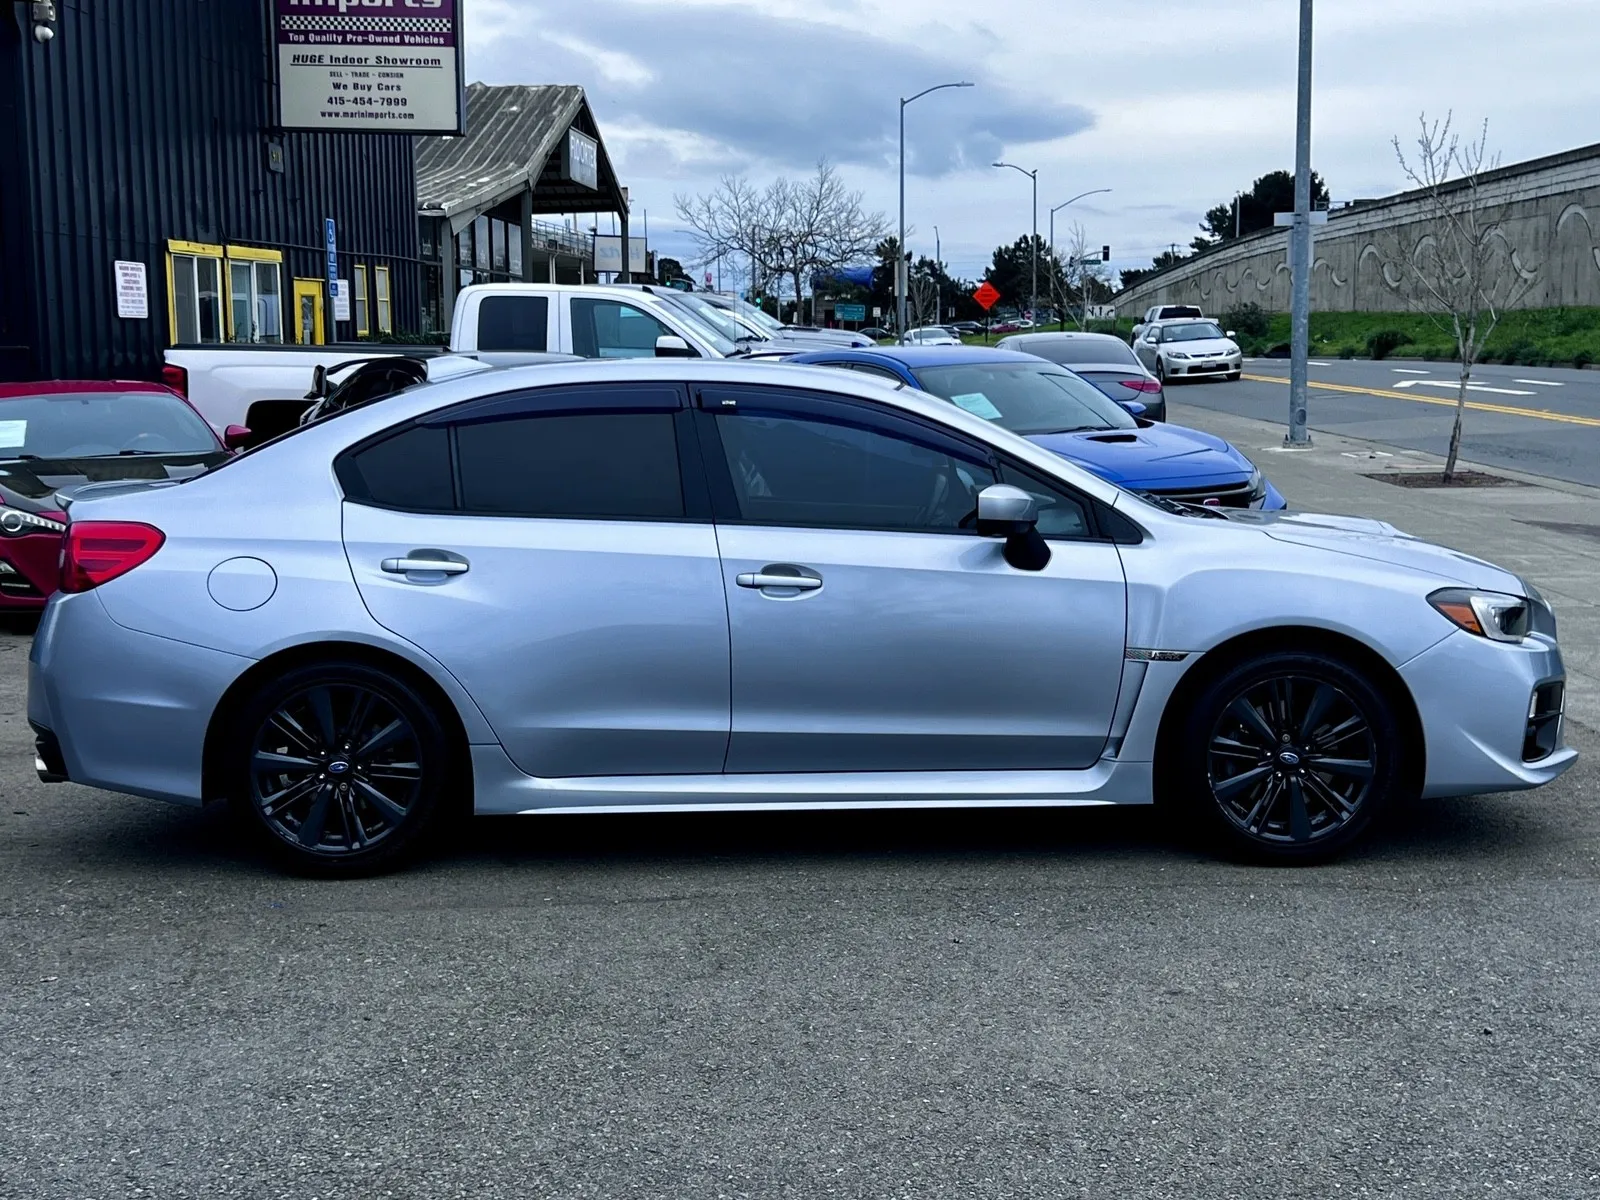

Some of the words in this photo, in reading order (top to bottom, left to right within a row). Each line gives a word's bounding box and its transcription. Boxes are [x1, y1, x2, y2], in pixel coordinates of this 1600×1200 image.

[288, 33, 305, 42] Top
[308, 33, 343, 43] Quality
[346, 34, 400, 43] Pre-Owned
[404, 35, 445, 44] Vehicles
[292, 54, 325, 64] HUGE
[329, 55, 370, 64] Indoor
[375, 55, 441, 65] Showroom
[332, 82, 348, 91] We
[352, 82, 372, 92] Buy
[377, 83, 402, 91] Cars
[327, 96, 407, 107] 415-454-7999
[320, 110, 415, 120] www.marinimports.com
